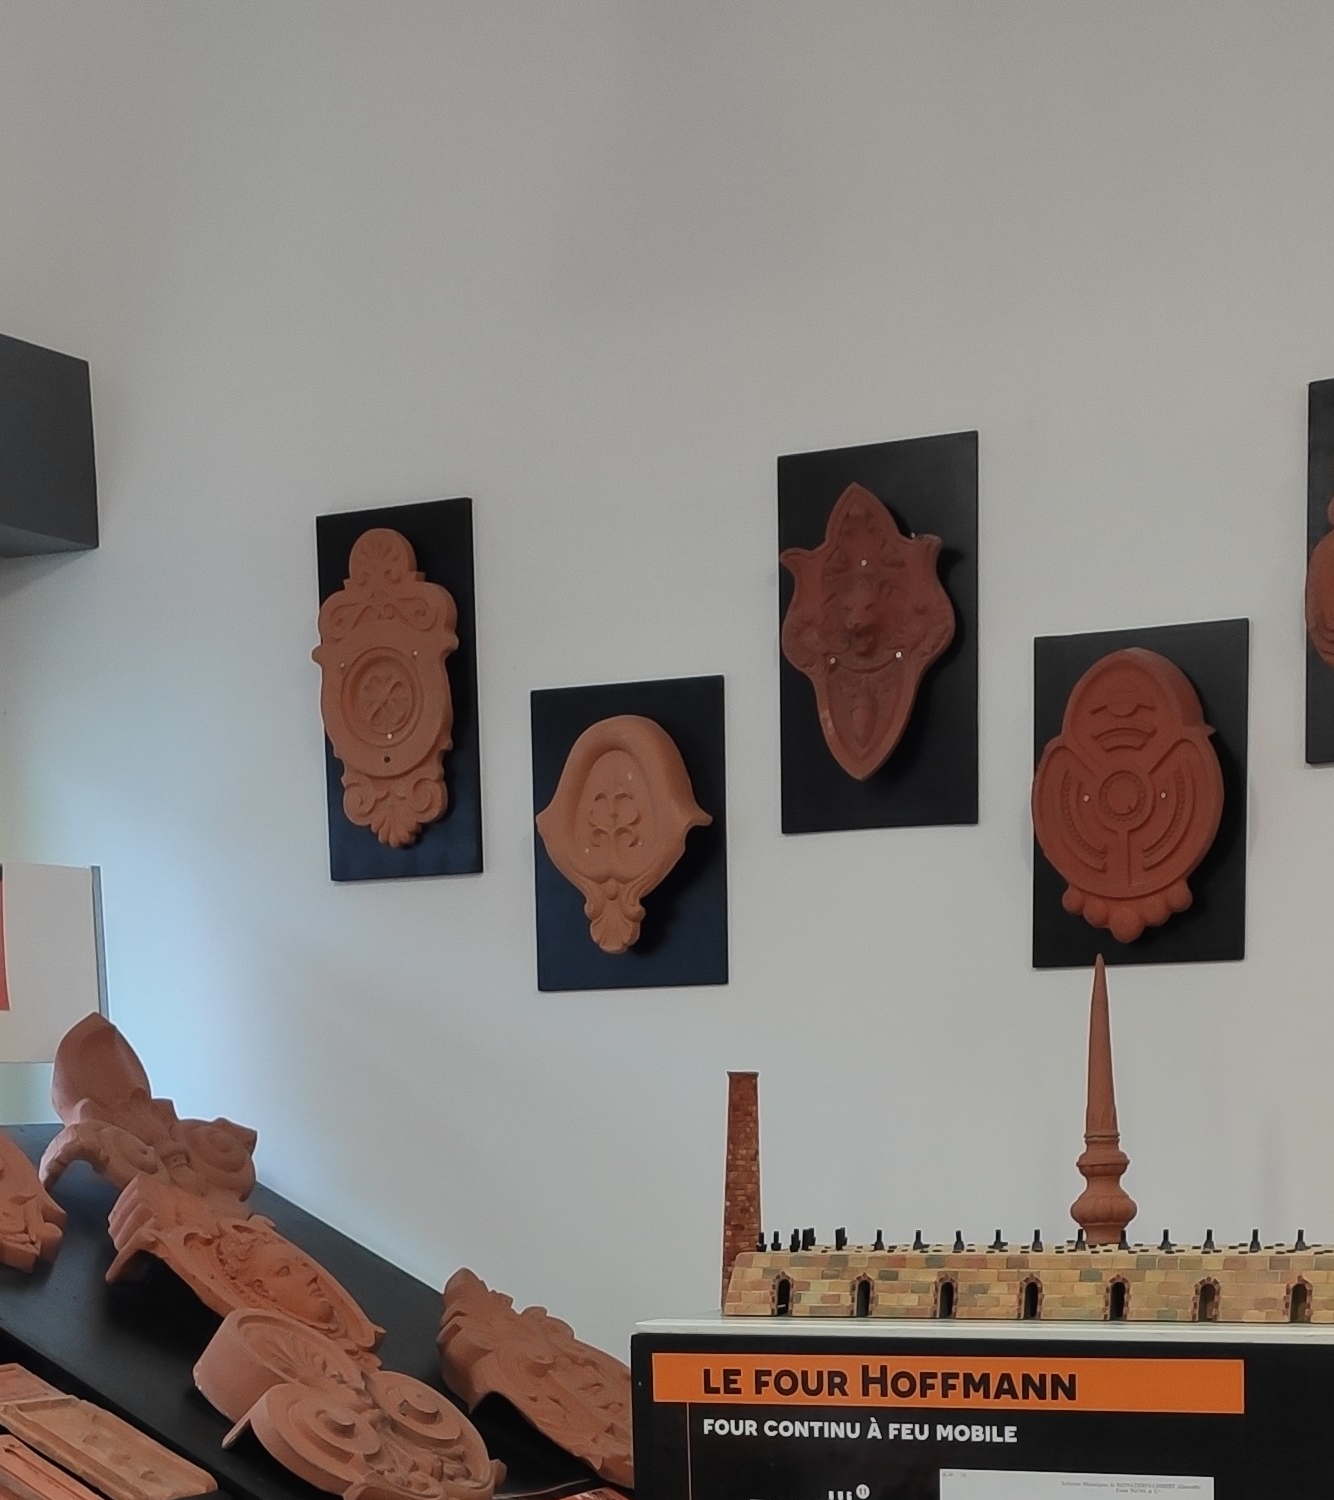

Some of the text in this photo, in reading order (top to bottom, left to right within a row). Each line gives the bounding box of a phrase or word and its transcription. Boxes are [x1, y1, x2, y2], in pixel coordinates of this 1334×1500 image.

[703, 1364, 1076, 1400] LE FOUR HOFFMANN
[703, 1416, 1017, 1442] FOUR CONTINU À FEU MOBILE
